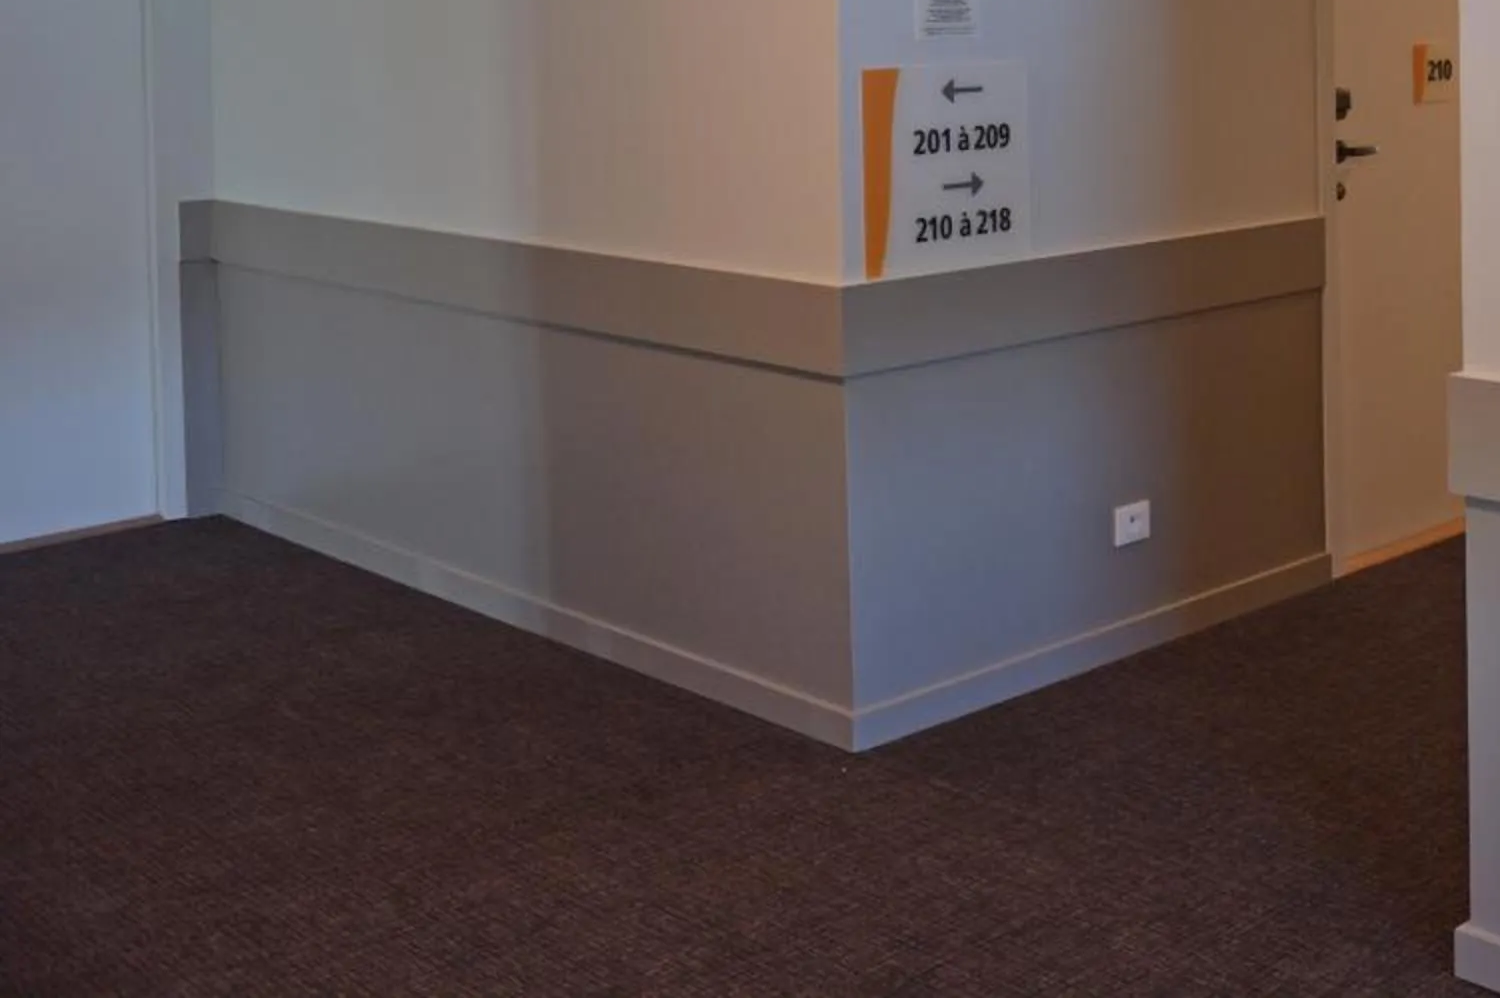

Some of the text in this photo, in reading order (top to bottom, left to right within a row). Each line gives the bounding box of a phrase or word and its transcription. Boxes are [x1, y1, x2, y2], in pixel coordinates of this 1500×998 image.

[1427, 59, 1453, 82] 210
[913, 123, 1010, 155] 201 à 209
[915, 207, 1011, 243] 210 à 218
